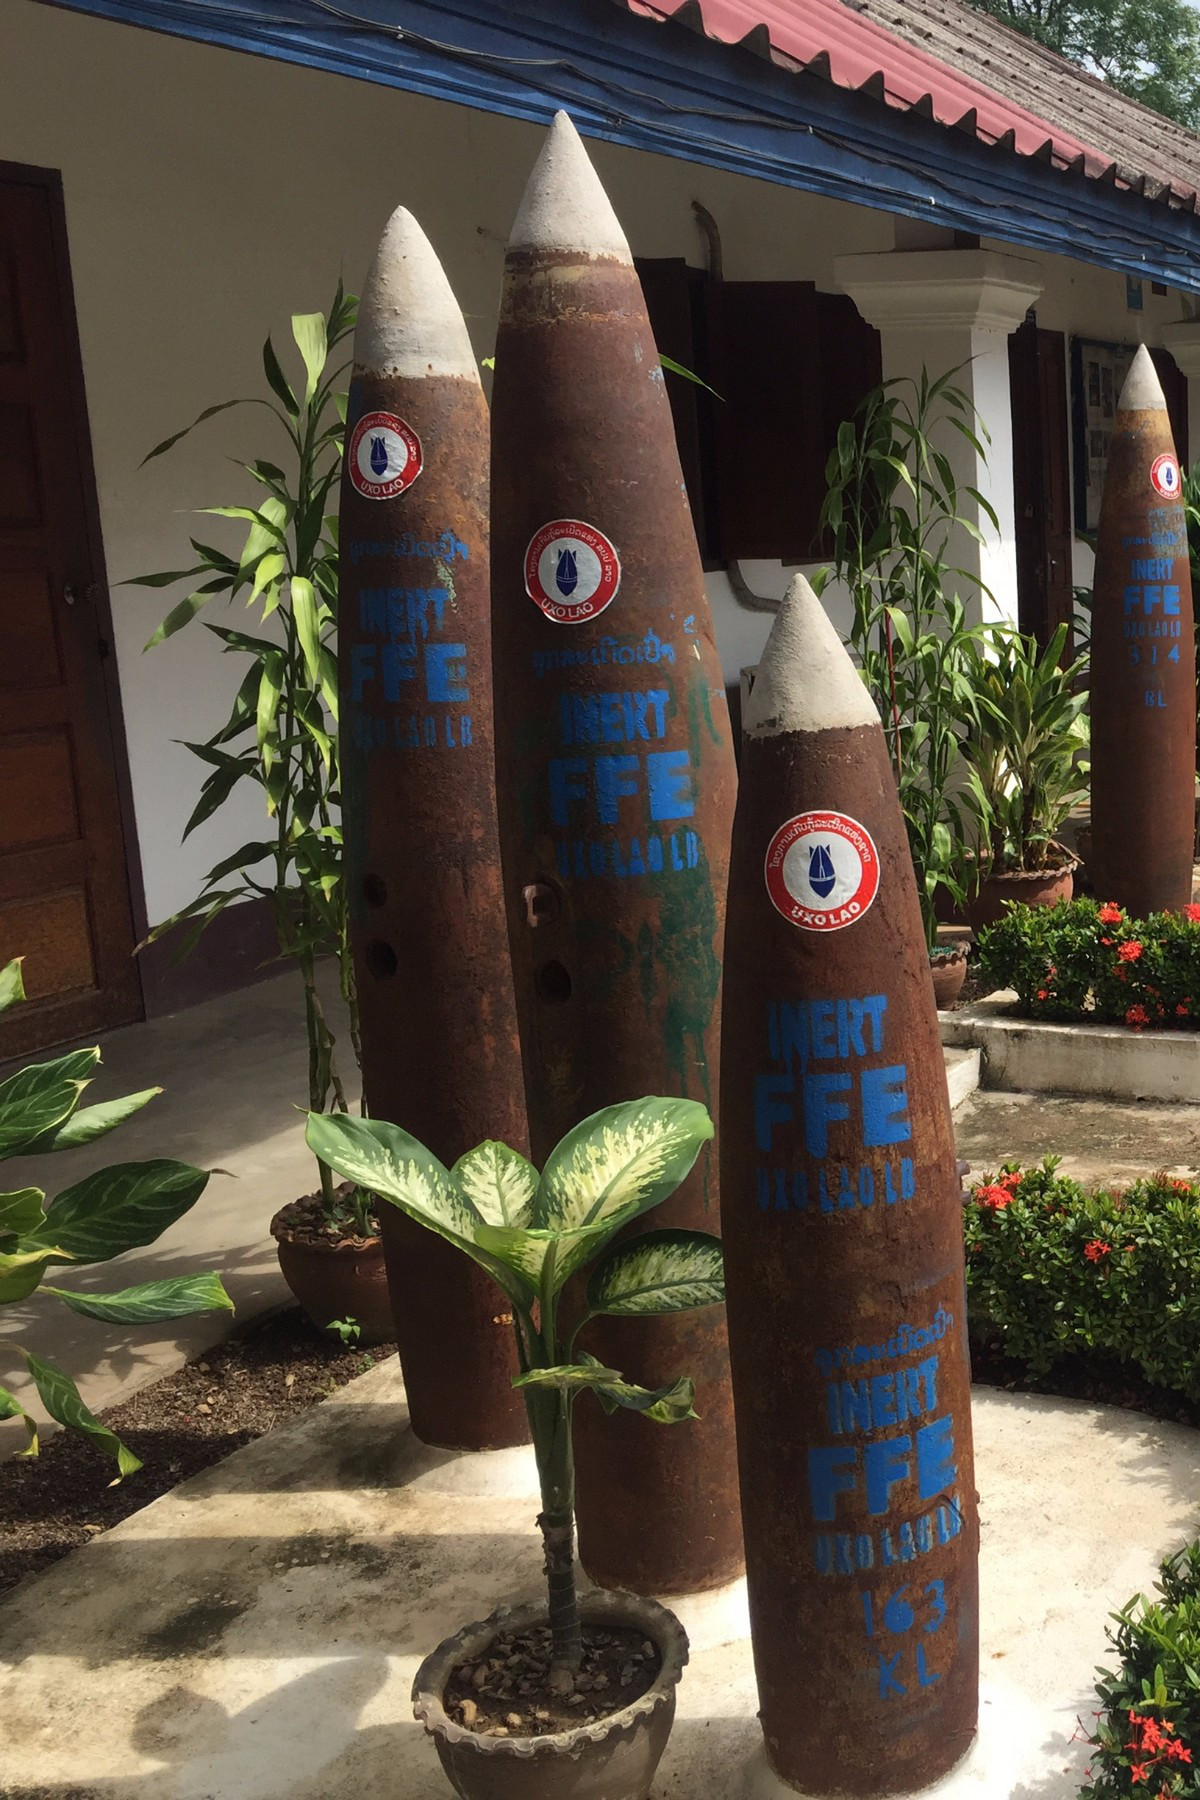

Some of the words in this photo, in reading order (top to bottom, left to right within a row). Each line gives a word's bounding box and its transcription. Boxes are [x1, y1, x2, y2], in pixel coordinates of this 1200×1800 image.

[360, 481, 381, 495] UXO
[382, 478, 404, 494] LAO
[1130, 557, 1174, 581] INERT
[358, 587, 450, 638] INERT
[541, 598, 566, 617] UXO
[568, 602, 594, 618] LAO
[1124, 585, 1180, 616] FFE
[351, 643, 470, 702] FFE
[560, 689, 670, 745] INERT
[549, 750, 695, 827] FFE
[556, 839, 607, 879] UXO
[613, 835, 663, 877] LAO
[791, 905, 827, 925] UXO
[829, 901, 861, 925] LAO
[768, 994, 888, 1062] INERT
[754, 1064, 911, 1159] FFE
[756, 1167, 808, 1212] UXO
[819, 1166, 875, 1213] LAO
[827, 1355, 939, 1435] INERT
[808, 1413, 958, 1521] FFE
[814, 1531, 875, 1576] UXO
[880, 1515, 934, 1567] LAO
[861, 1578, 947, 1637] 163
